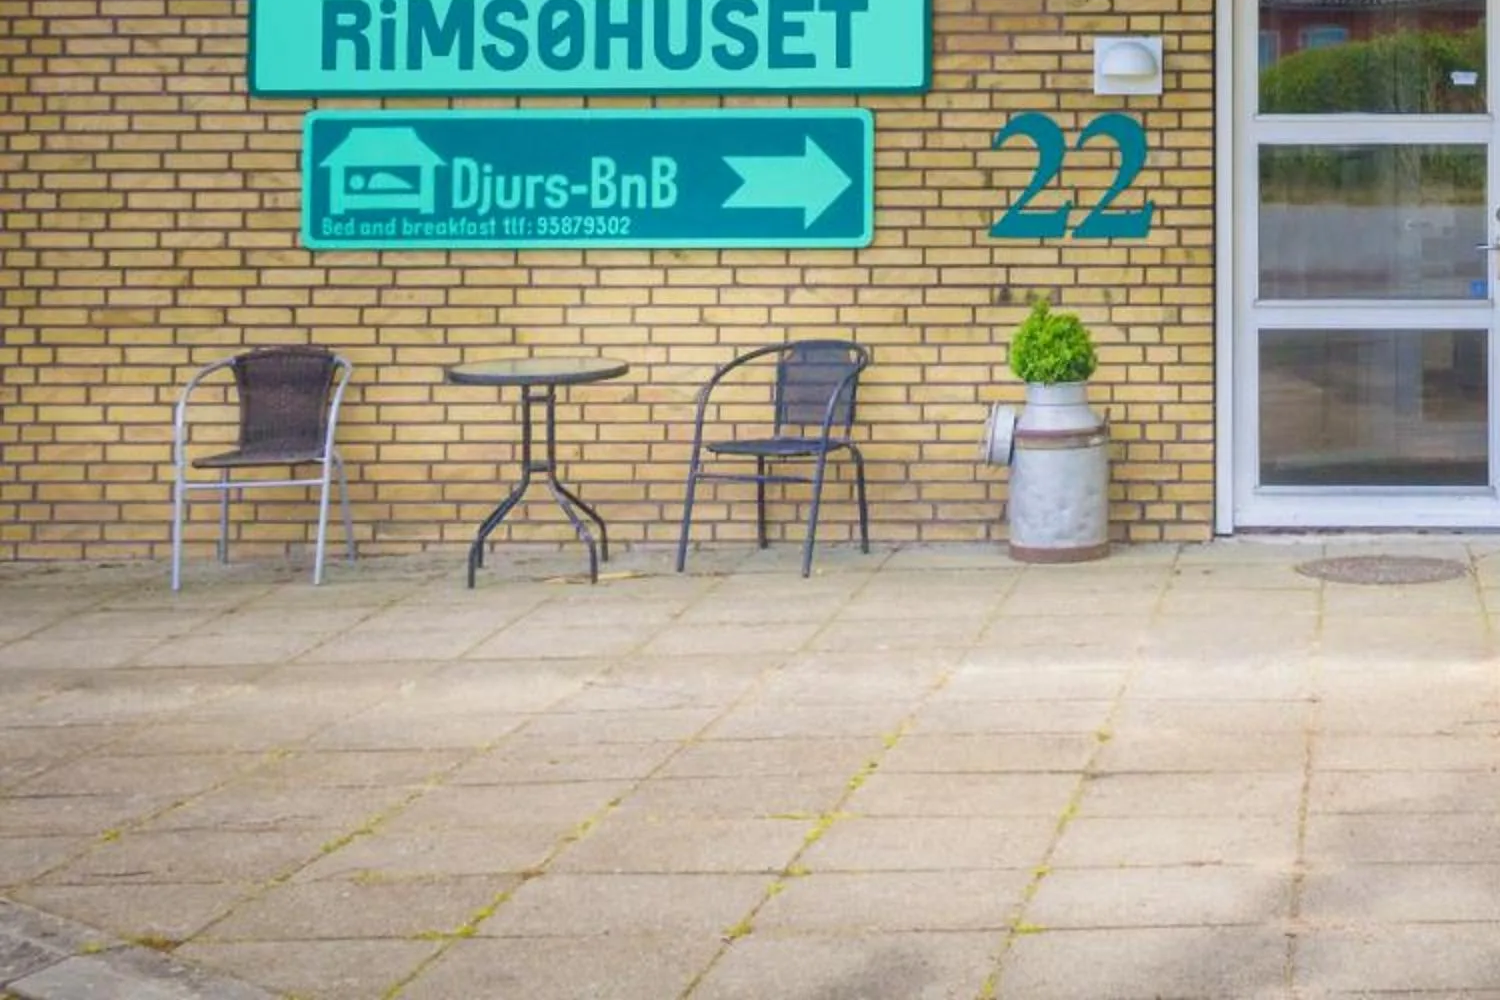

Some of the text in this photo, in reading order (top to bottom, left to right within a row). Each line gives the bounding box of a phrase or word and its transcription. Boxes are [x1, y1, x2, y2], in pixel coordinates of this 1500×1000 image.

[451, 156, 678, 216] Djurs-BnB
[989, 112, 1155, 239] 22
[321, 217, 356, 236] Bed
[359, 217, 397, 236] and
[402, 217, 496, 236] breakfast
[503, 216, 533, 236] tlf:
